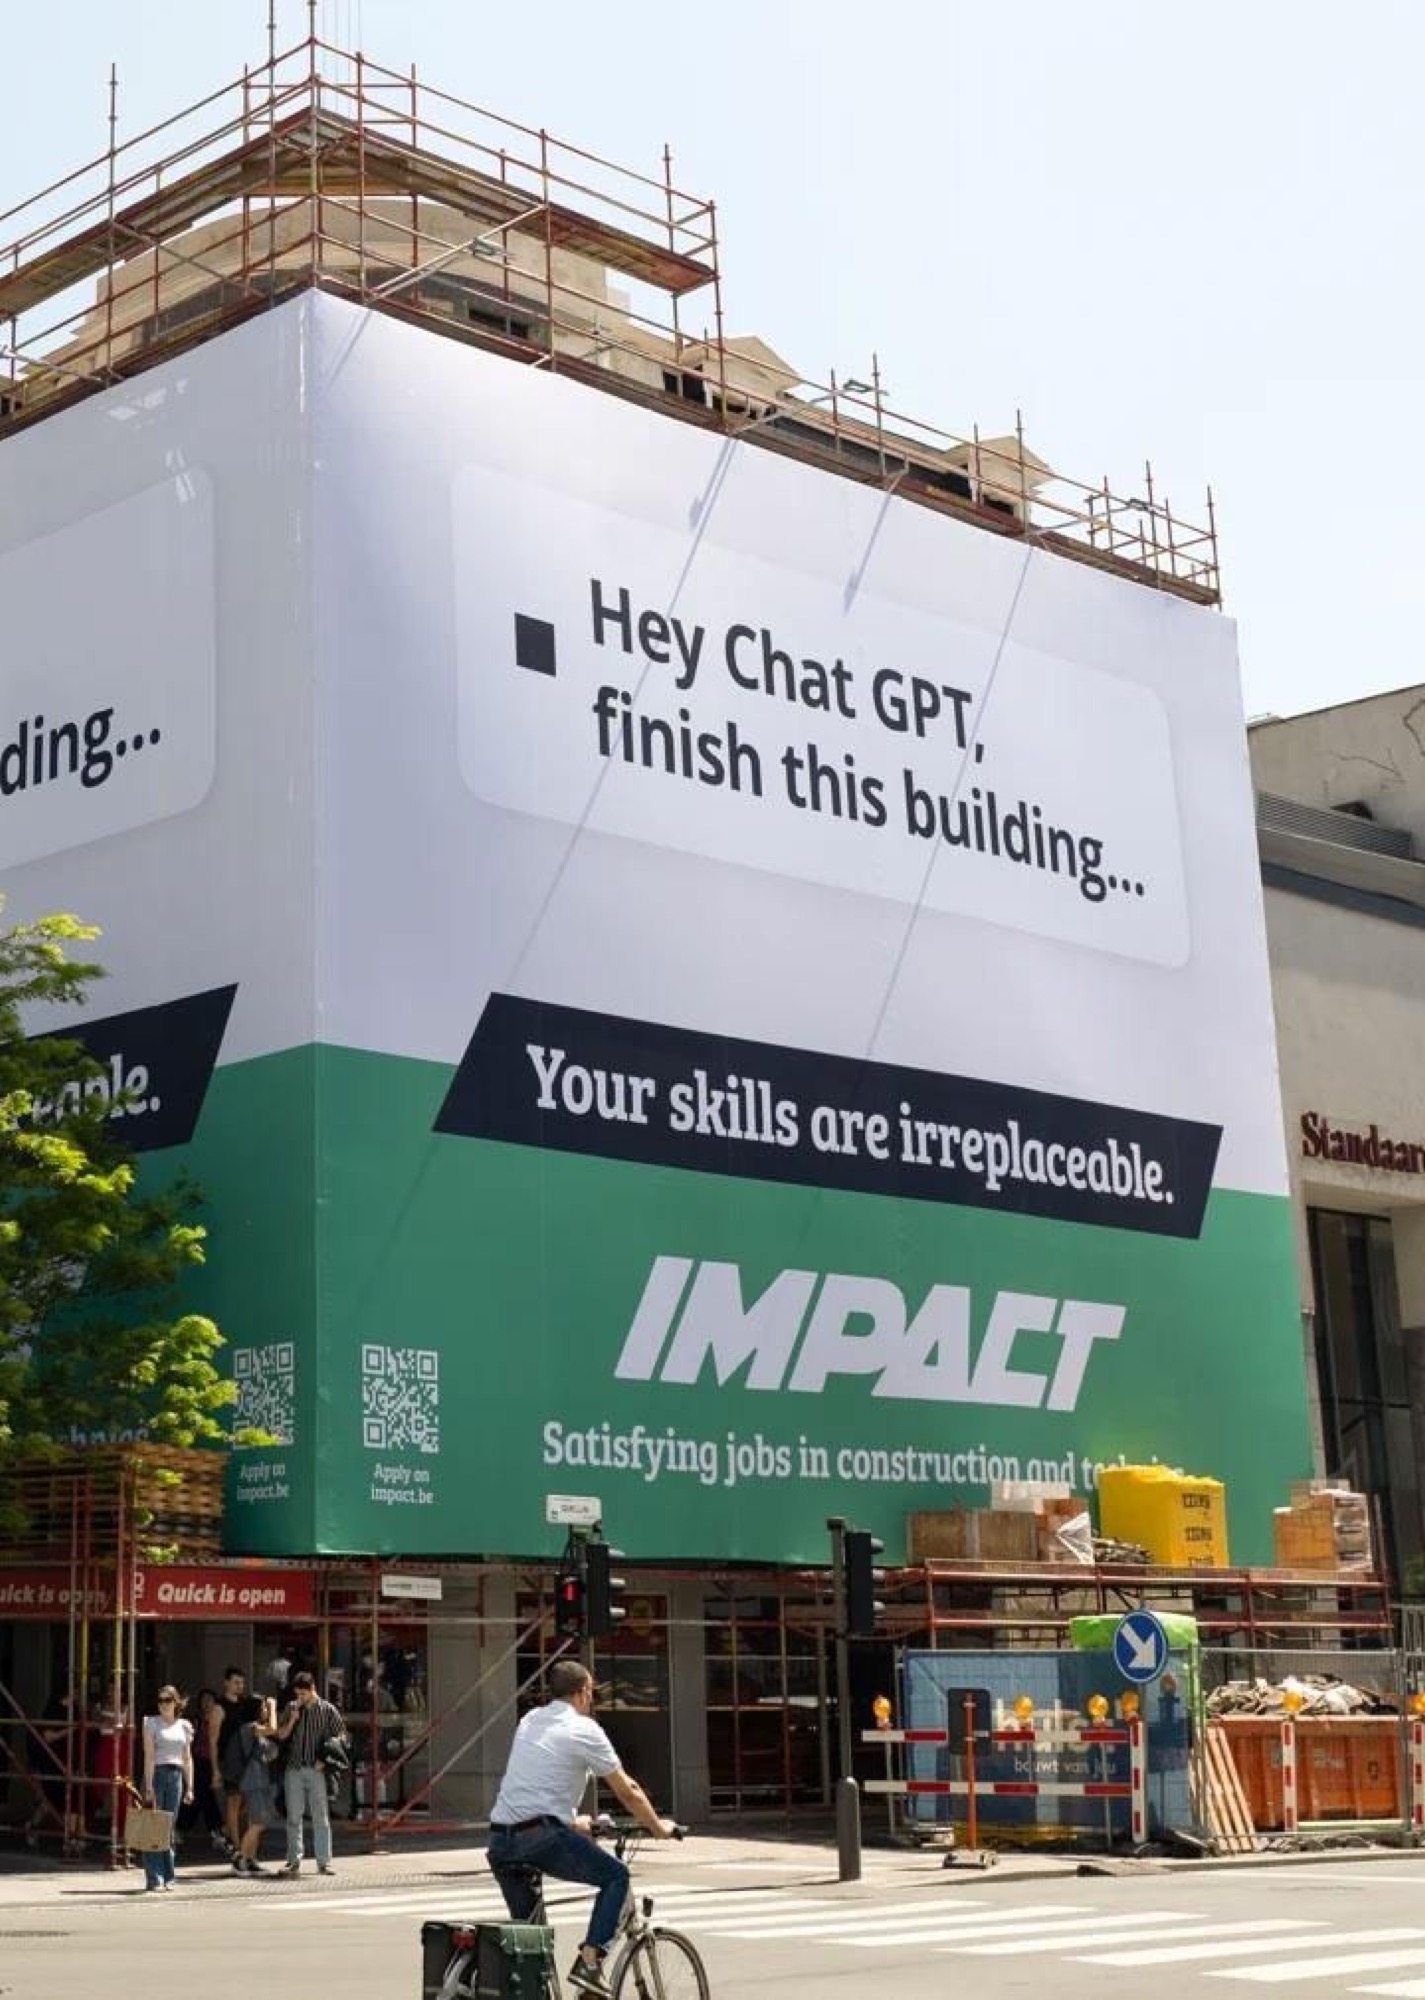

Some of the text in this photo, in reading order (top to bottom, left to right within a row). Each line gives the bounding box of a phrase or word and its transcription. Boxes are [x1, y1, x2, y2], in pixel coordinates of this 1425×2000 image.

[591, 577, 985, 764] Hey Chat GPT,
[0, 706, 161, 796] ding...
[592, 685, 1145, 903] finish this building...
[525, 1043, 1174, 1204] Your skills are irreplaceable.
[613, 1254, 1127, 1413] IMPACT
[370, 1484, 434, 1506] impact.be
[373, 1462, 431, 1485] Apply on
[543, 1420, 718, 1485] Satisfying
[723, 1432, 792, 1487] jobs
[799, 1436, 830, 1477] in
[836, 1442, 1021, 1485] construction
[1026, 1450, 1077, 1490] and
[157, 1582, 216, 1604] Quick
[217, 1583, 237, 1605] is
[238, 1588, 286, 1609] open
